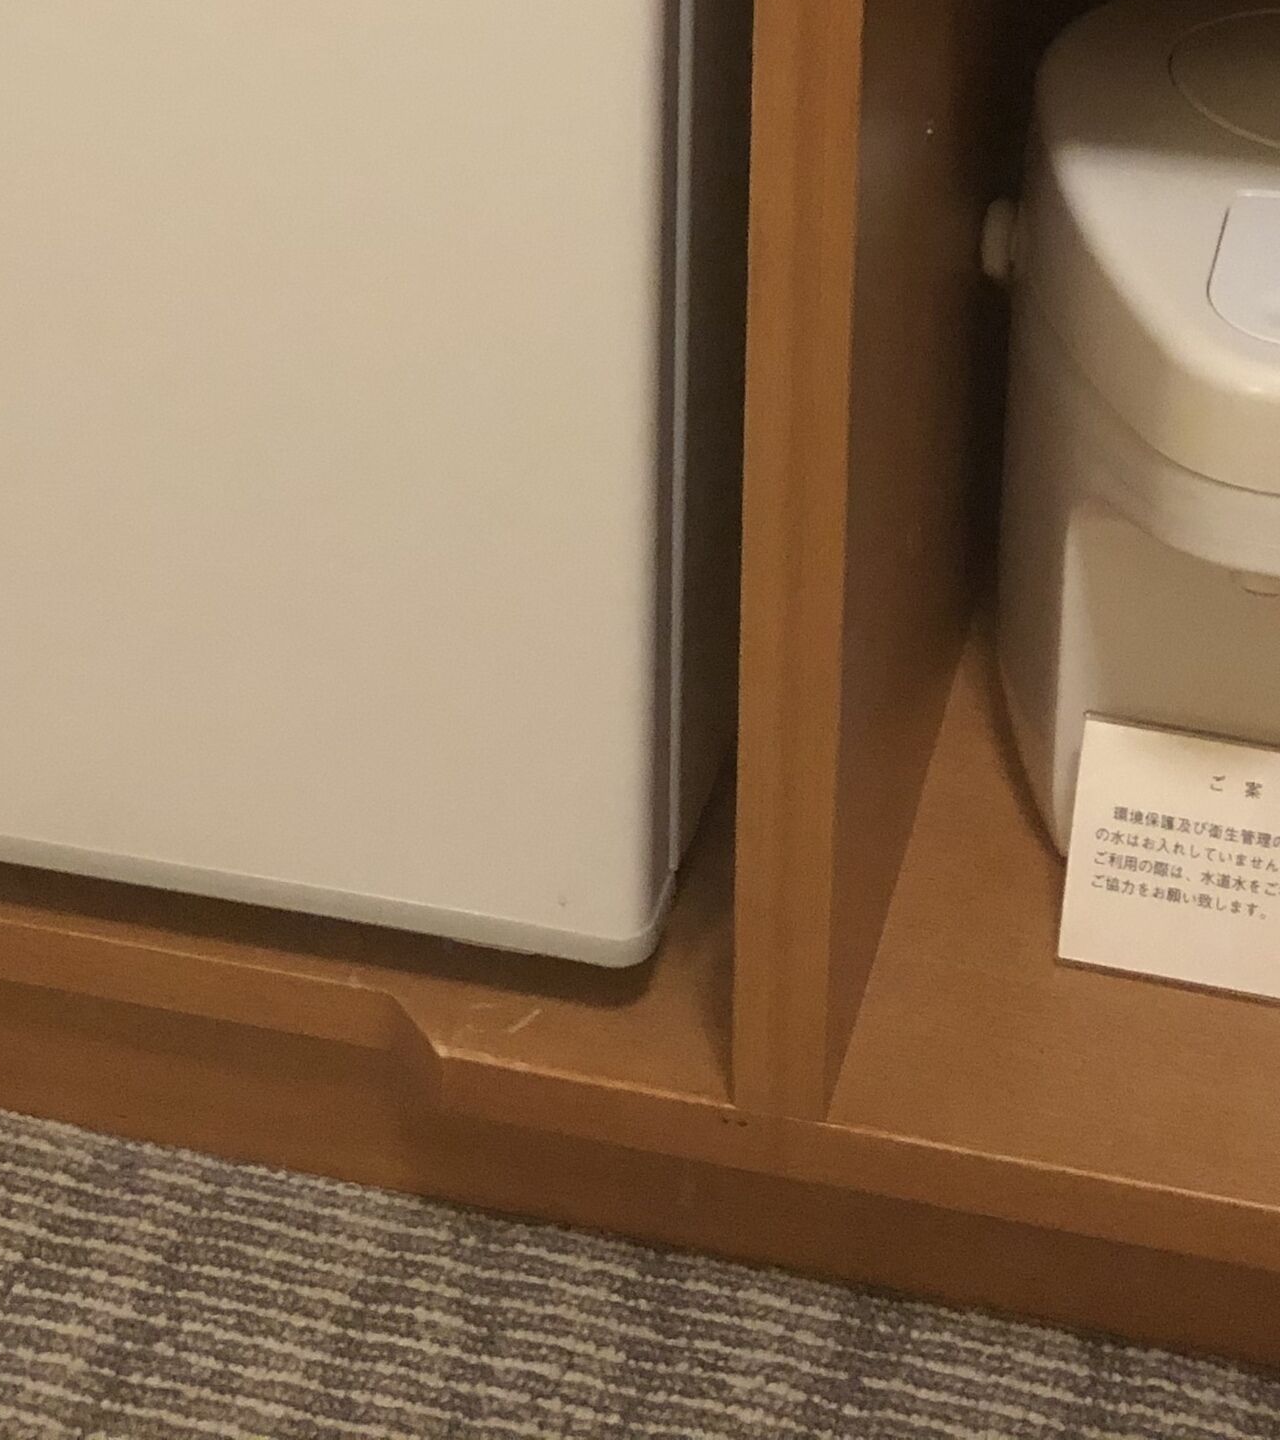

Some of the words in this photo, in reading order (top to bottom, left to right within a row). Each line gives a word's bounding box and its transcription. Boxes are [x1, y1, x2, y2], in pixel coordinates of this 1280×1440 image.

[1090, 875, 1268, 921] ご協力をお願い致します。
